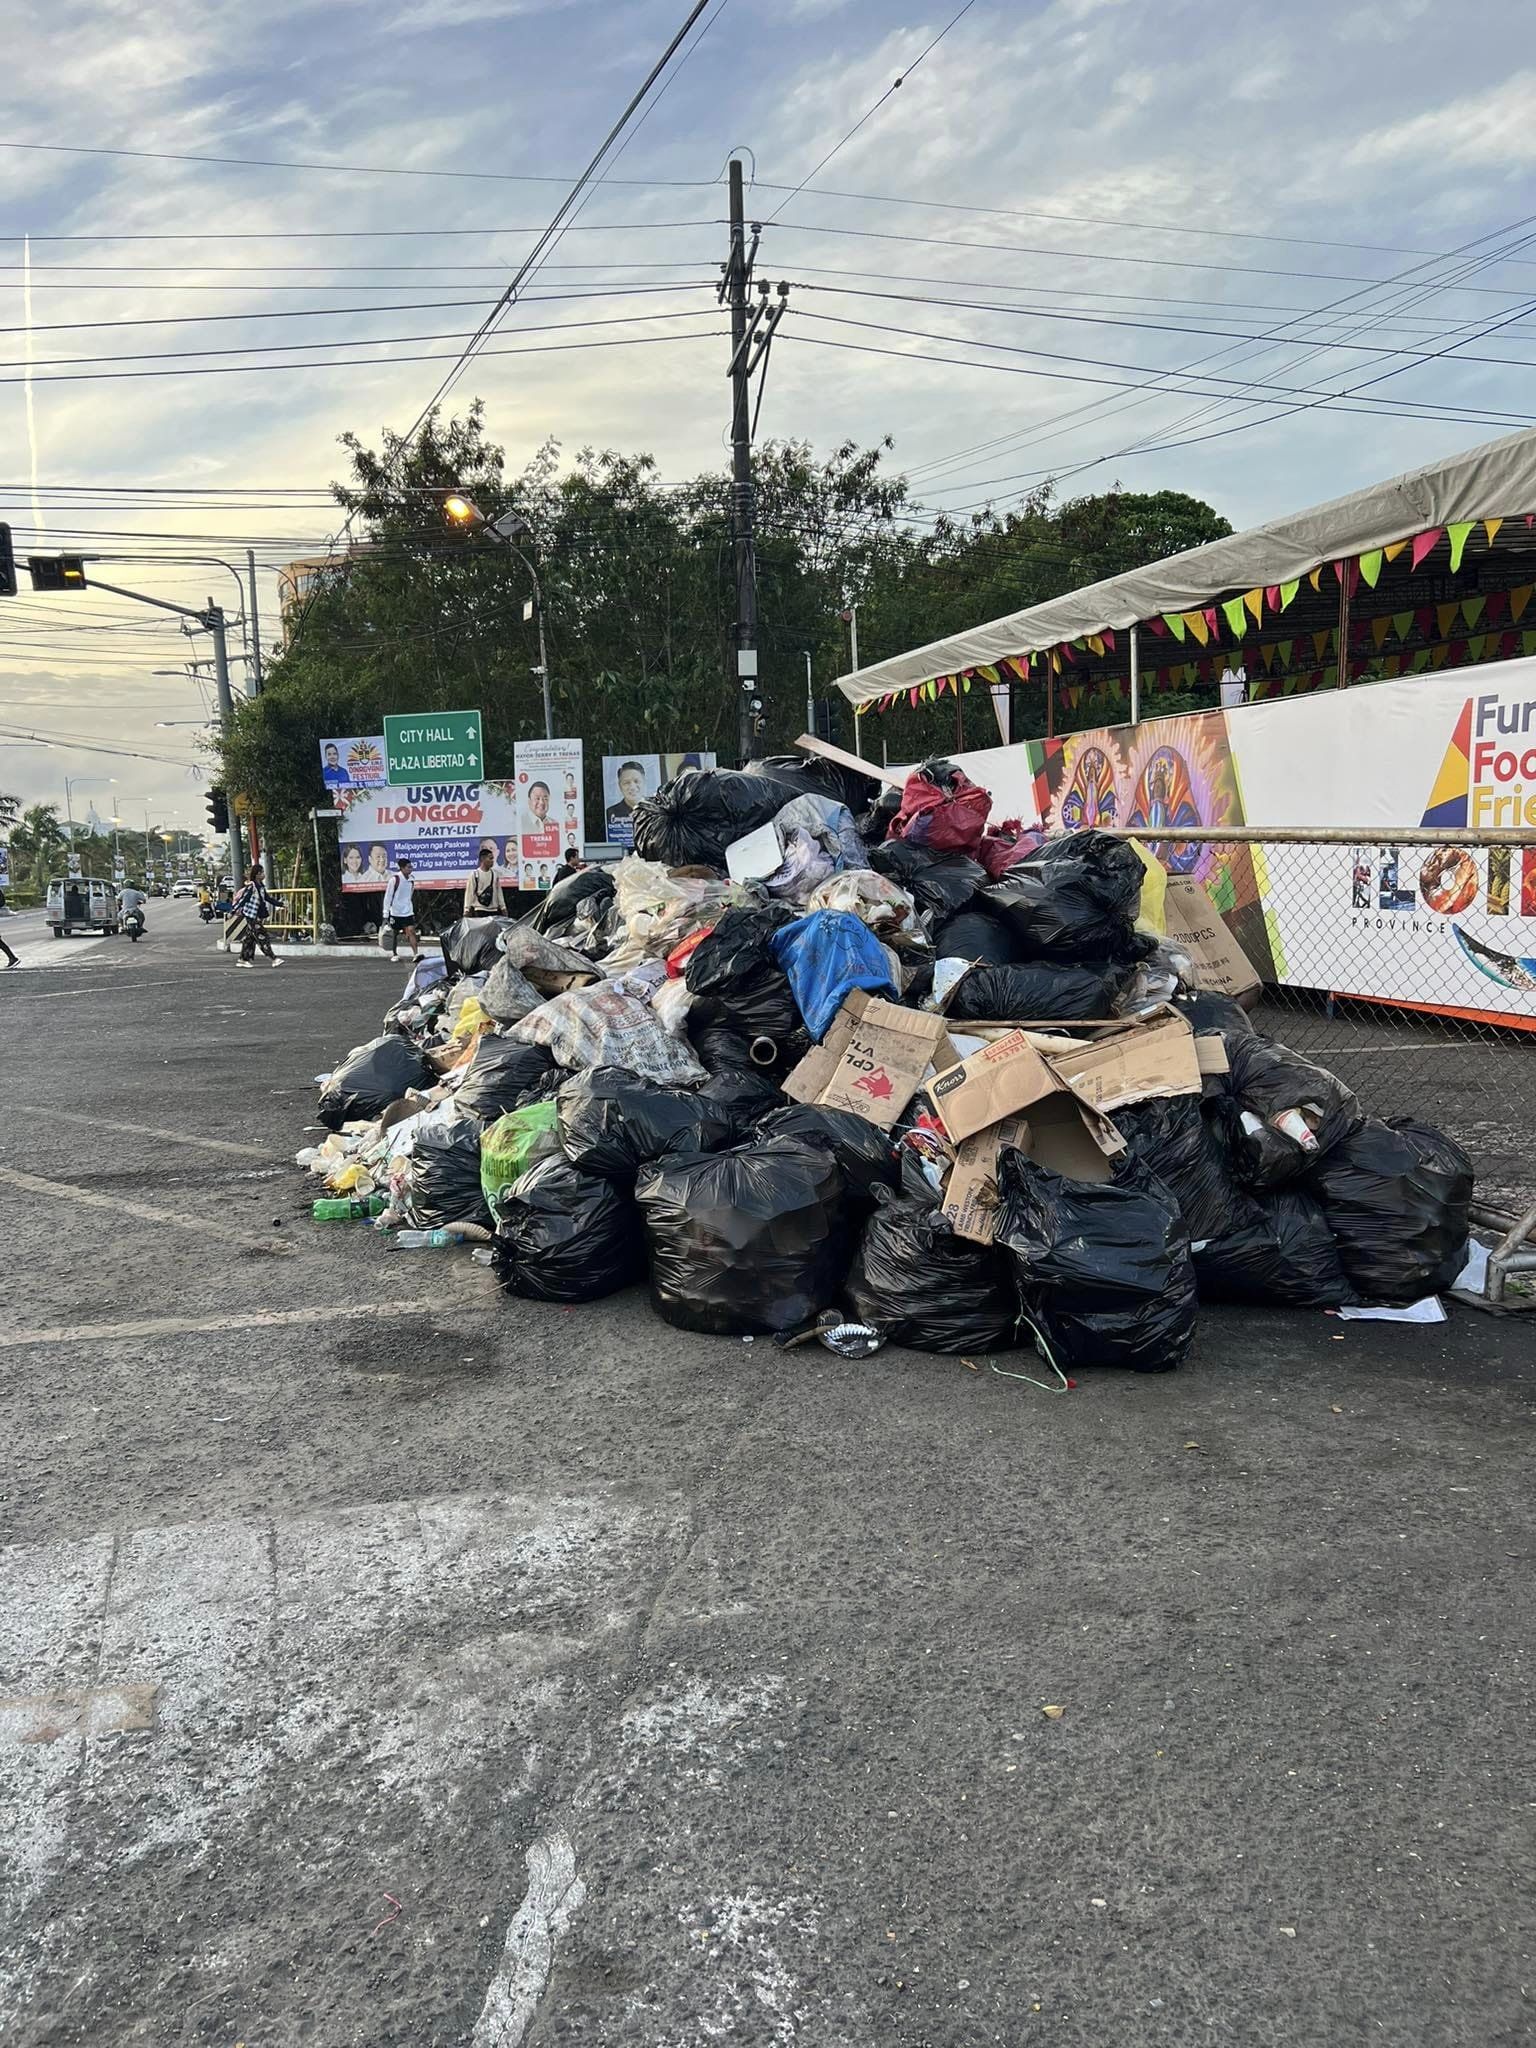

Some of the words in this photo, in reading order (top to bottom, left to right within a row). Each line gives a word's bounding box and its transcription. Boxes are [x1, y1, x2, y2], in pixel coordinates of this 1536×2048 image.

[400, 729, 424, 743] CITY
[426, 728, 454, 742] HALL
[389, 756, 420, 770] PLAZA
[422, 754, 465, 769] LIBERTAD
[406, 784, 480, 804] USWAG
[377, 803, 472, 824] ILONGGO
[418, 825, 478, 836] PARTY-LIST
[394, 842, 430, 851] Malipayon
[430, 842, 443, 850] nga
[444, 840, 470, 848] Paskwa
[396, 852, 408, 860] kag
[410, 851, 456, 859] mainuswagon
[419, 860, 433, 868] Tuig
[1352, 918, 1445, 934] PROVINCE
[846, 1054, 874, 1072] CPL
[935, 1073, 965, 1093] Knorr
